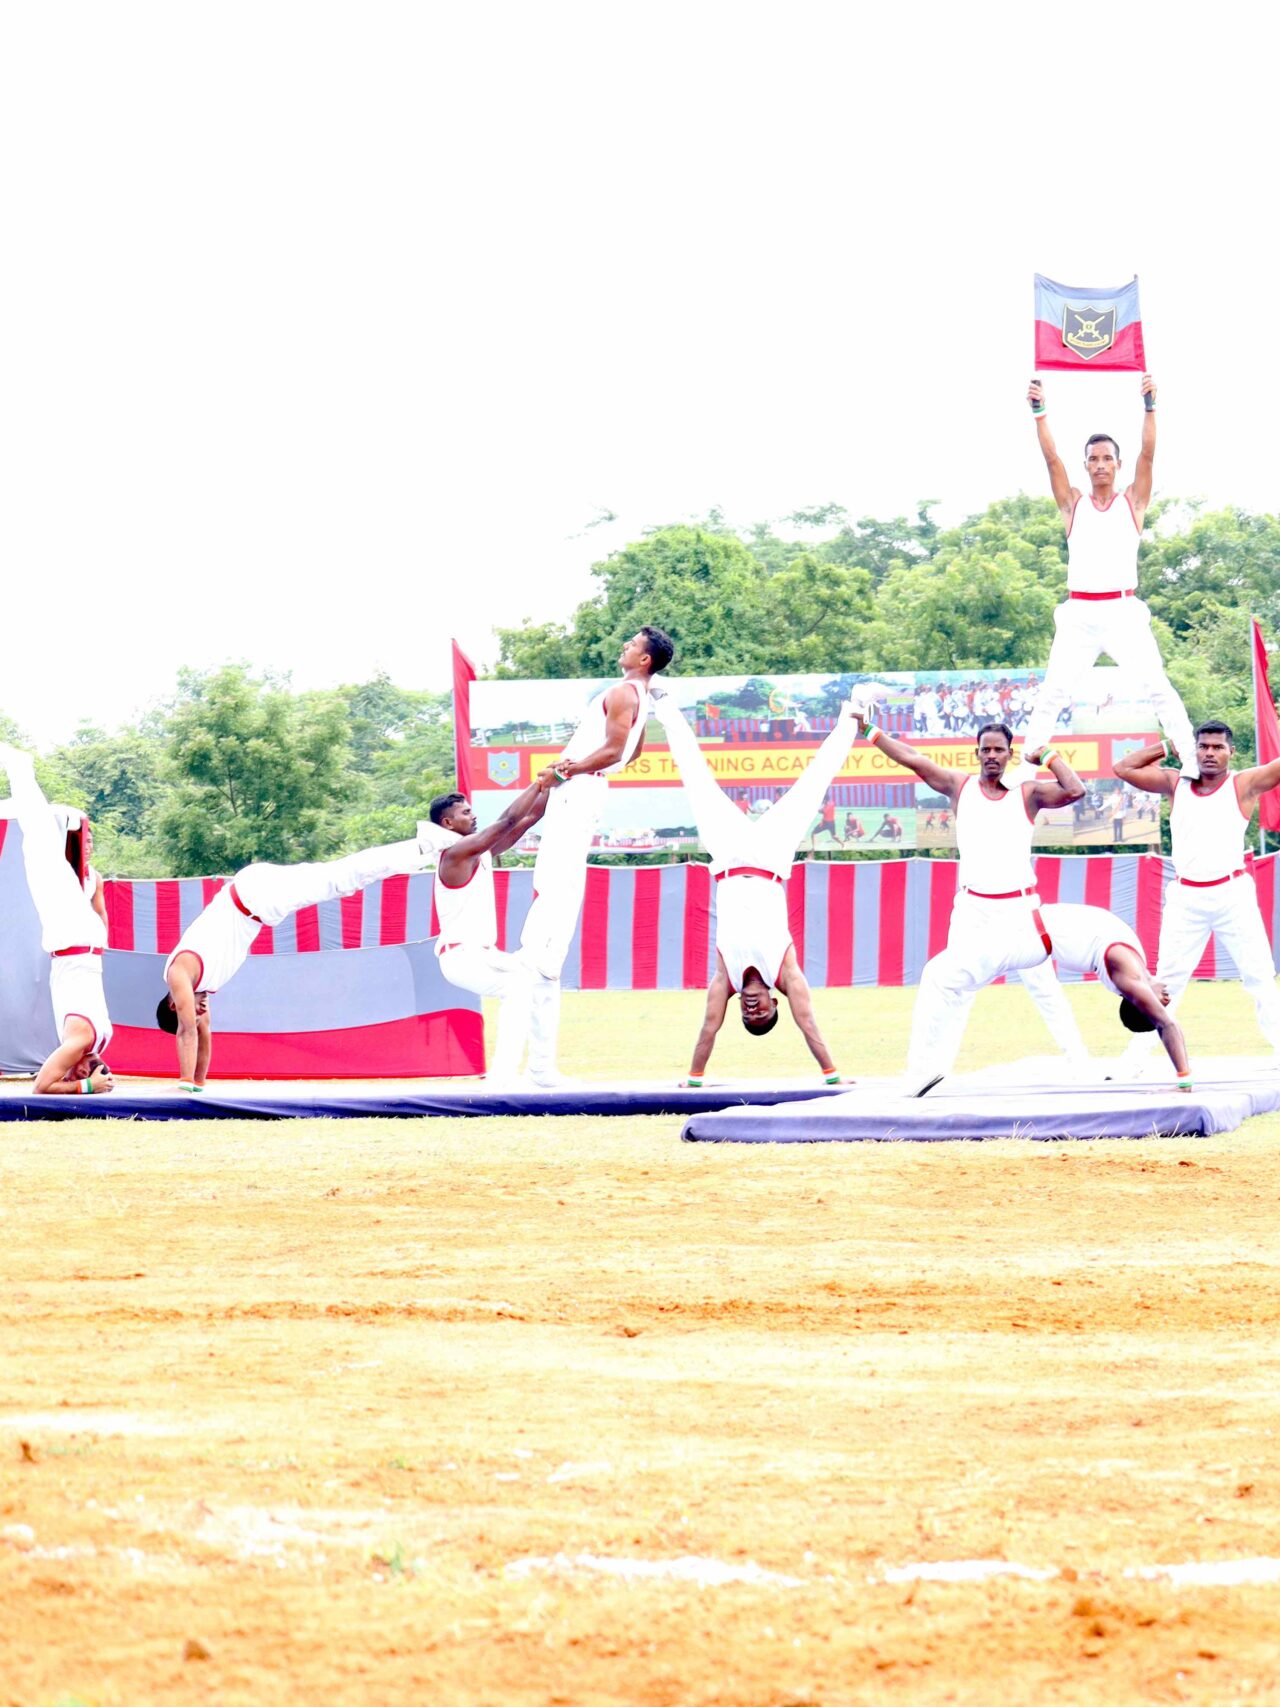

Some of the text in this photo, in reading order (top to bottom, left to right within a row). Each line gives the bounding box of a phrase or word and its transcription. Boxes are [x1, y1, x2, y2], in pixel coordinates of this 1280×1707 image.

[658, 757, 755, 773] TNING
[761, 755, 863, 771] ACAY
[871, 752, 981, 769] COINED
